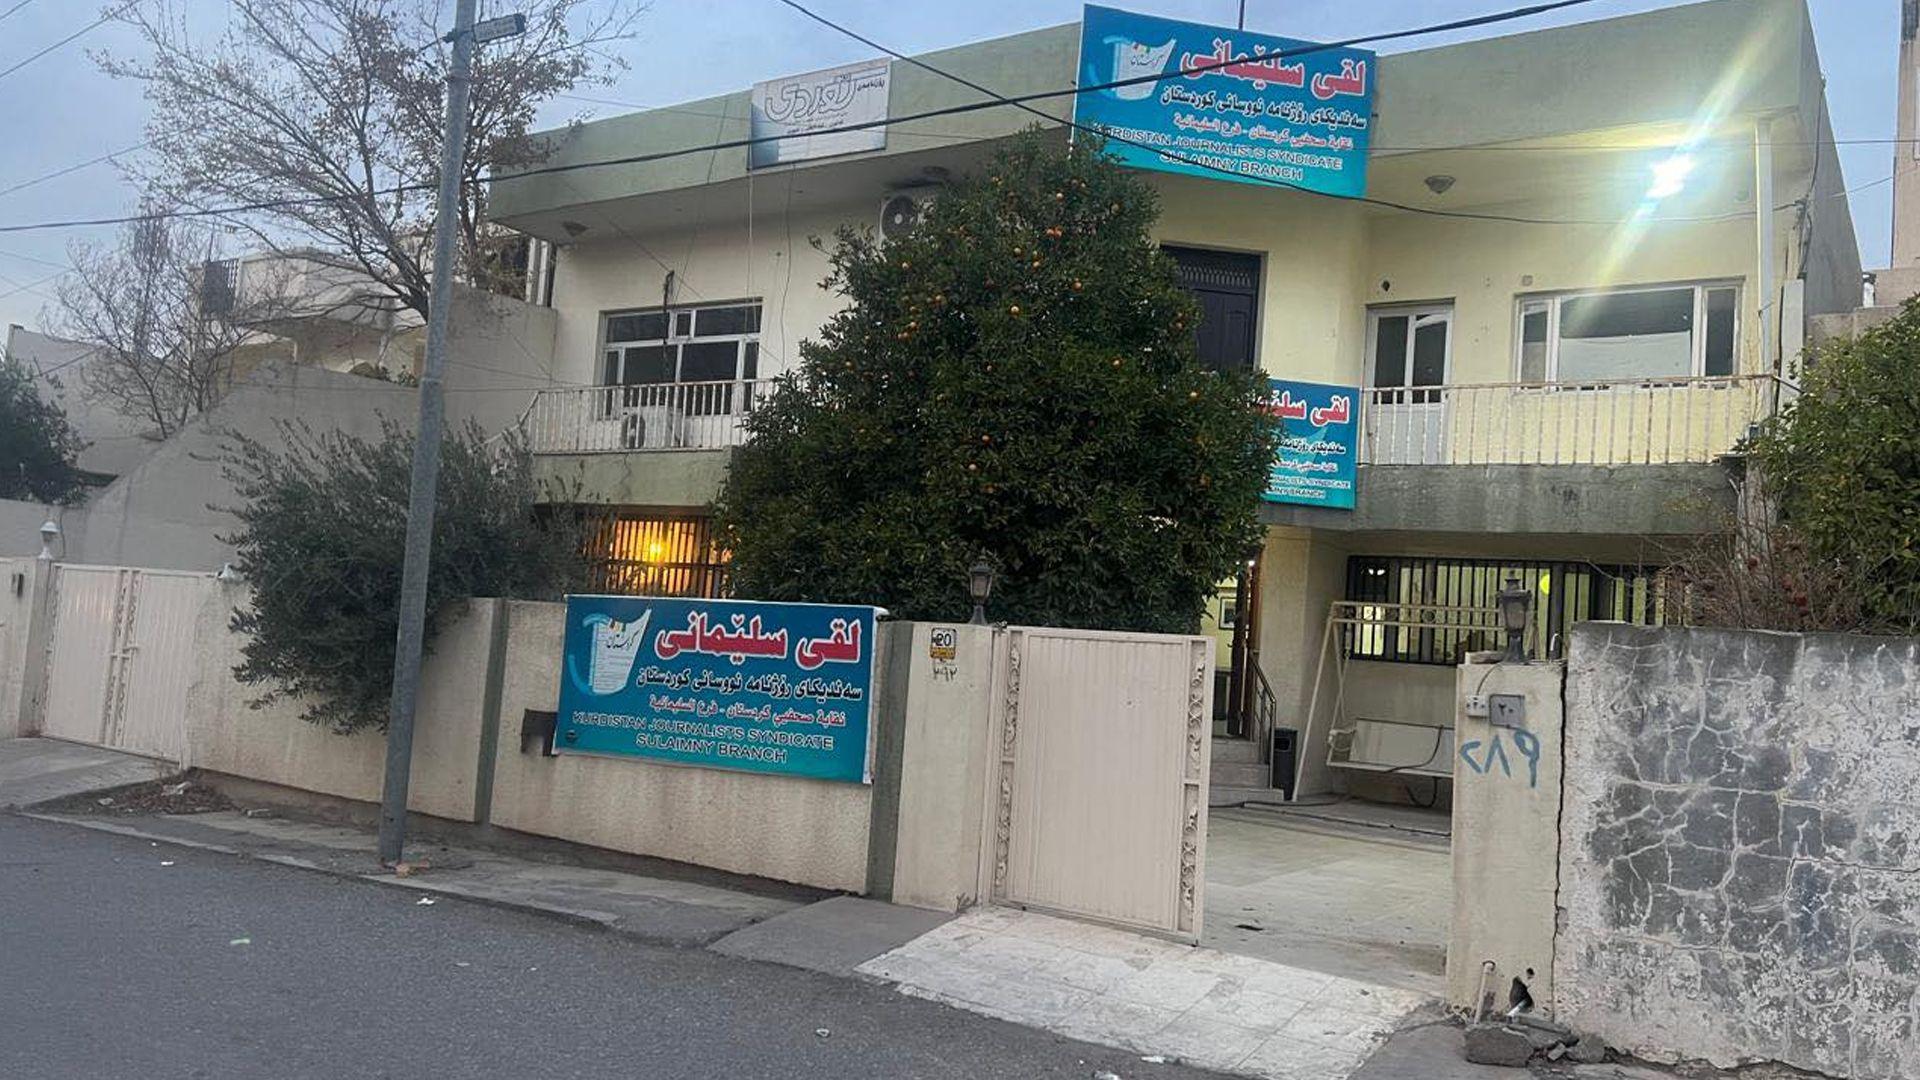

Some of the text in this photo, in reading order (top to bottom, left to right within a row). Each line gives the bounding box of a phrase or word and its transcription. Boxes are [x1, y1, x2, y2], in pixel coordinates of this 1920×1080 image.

[1310, 58, 1366, 99] لقی
[1240, 160, 1304, 180] BRANCH
[1267, 147, 1343, 170] SYNDICATE
[1310, 395, 1350, 427] لقی
[655, 609, 861, 670] لقی سلێمانی
[572, 711, 834, 750] KURDISTAN JOURNALISTS SYNDICATE
[635, 733, 787, 763] SULAIMNY BRANCH
